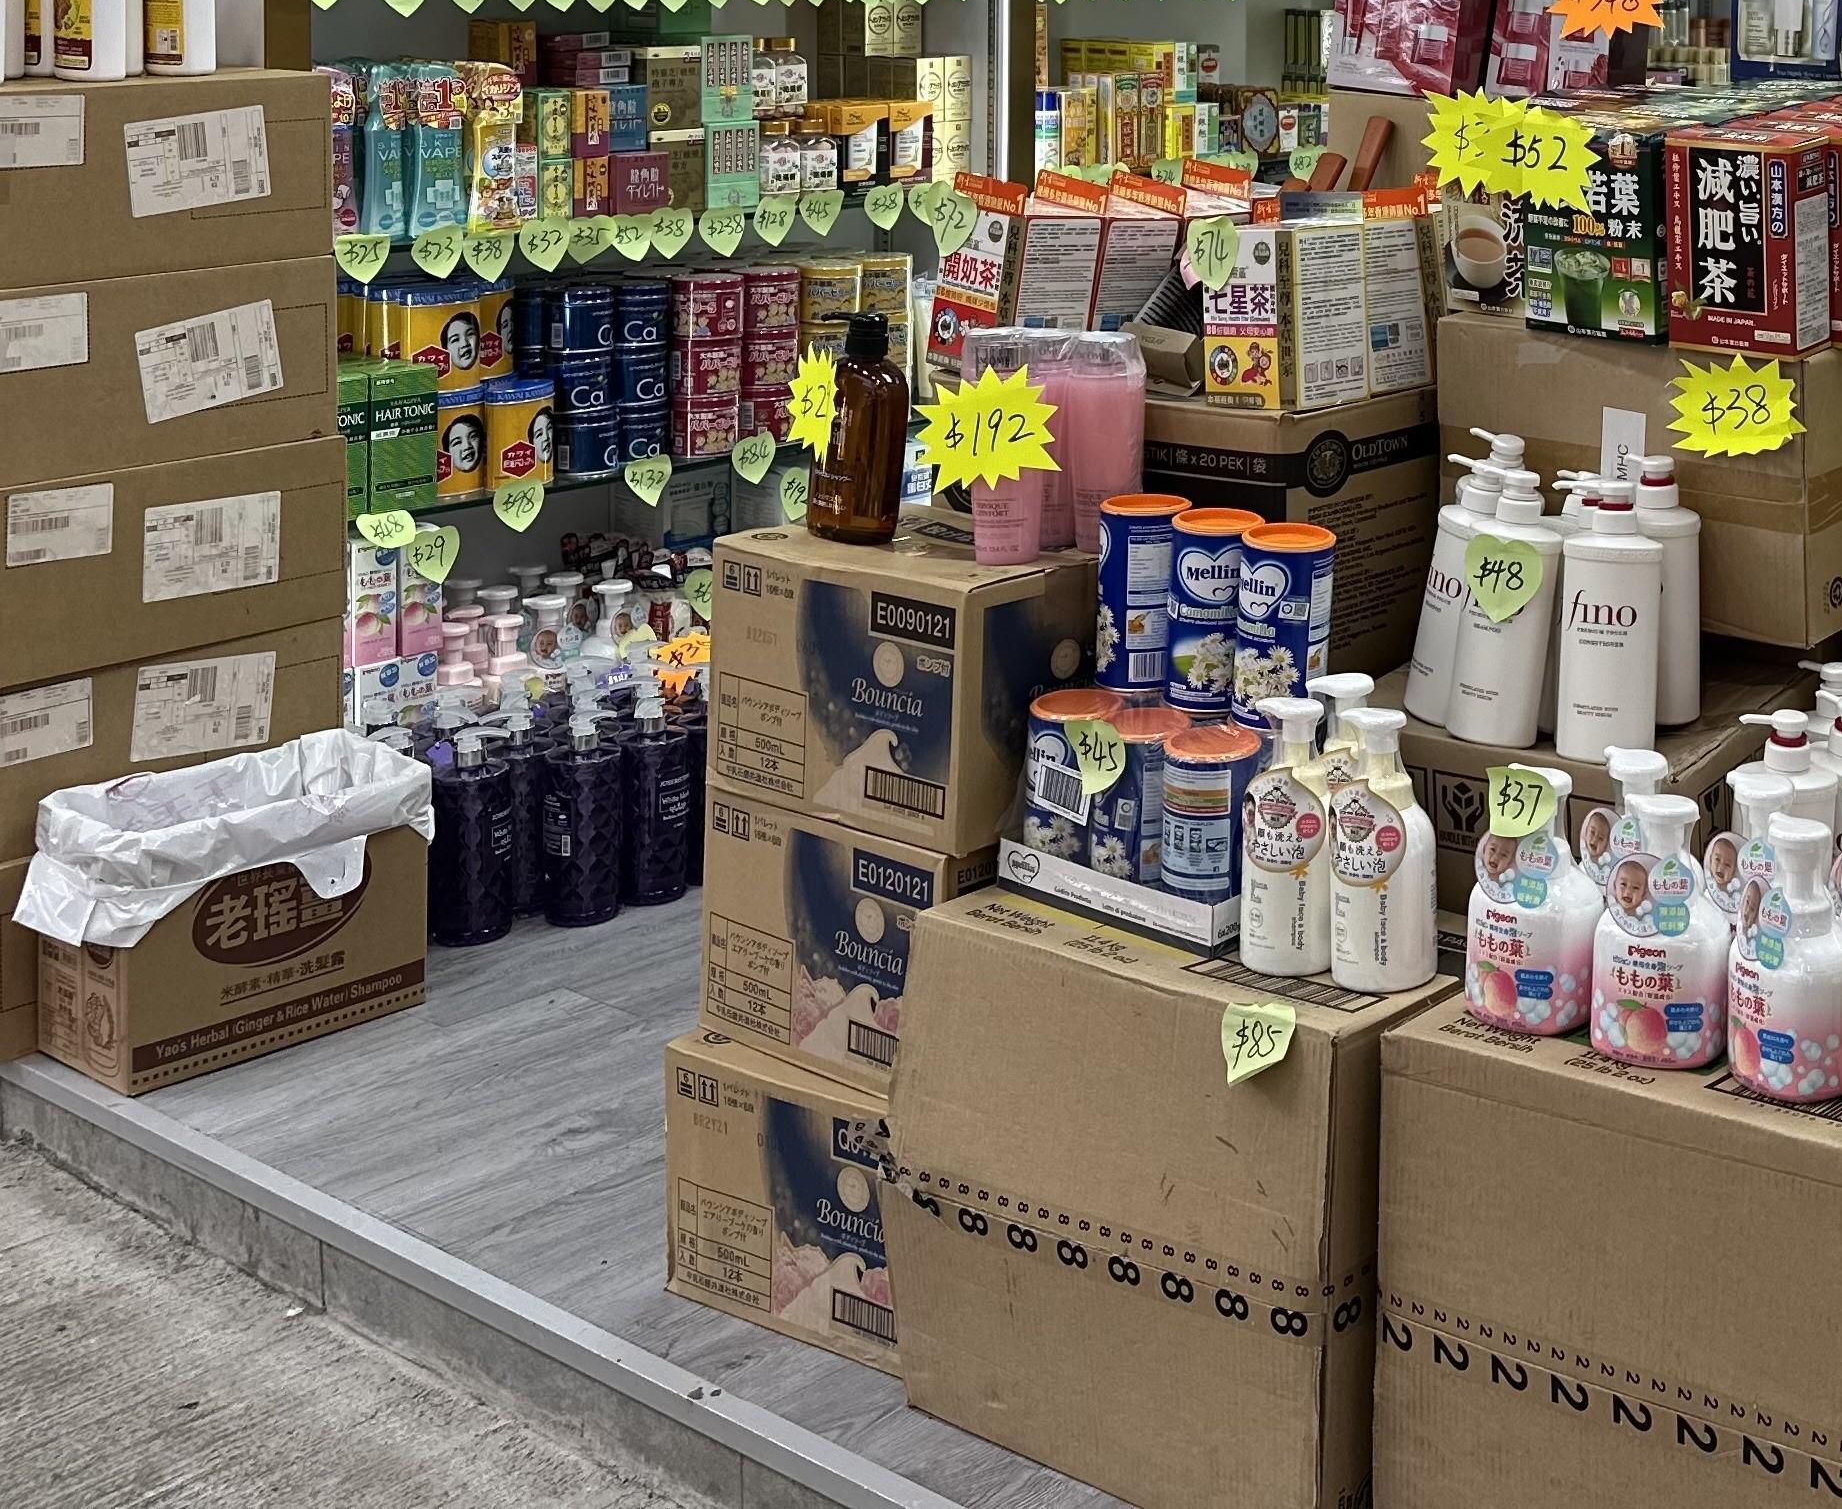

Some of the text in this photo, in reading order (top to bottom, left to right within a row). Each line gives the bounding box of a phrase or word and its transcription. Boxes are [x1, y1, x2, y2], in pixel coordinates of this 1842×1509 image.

[421, 146, 462, 159] VAPE
[1501, 129, 1569, 172] $52
[1770, 166, 1785, 234] 山本漢方の
[653, 218, 685, 238] $38
[707, 214, 743, 236] $238
[758, 210, 788, 228] $128
[1608, 218, 1642, 240] 粉末
[1697, 157, 1738, 304] 減肥茶
[344, 241, 382, 263] $25
[419, 237, 455, 261] $23
[472, 240, 503, 262] $38
[528, 231, 562, 254] $32
[1193, 230, 1229, 276] $74
[1209, 284, 1270, 317] 七星茶
[624, 321, 657, 342] Ca
[571, 386, 604, 408] Ca
[637, 378, 665, 398] Ca
[375, 403, 436, 423] HAIR TONIC
[1702, 385, 1772, 434] $38
[944, 408, 1035, 457] $192
[1199, 453, 1244, 470] 20 PEK
[413, 536, 445, 567] $29
[1186, 564, 1240, 581] Mellin
[1473, 556, 1525, 593] $48
[877, 602, 952, 640] E0090121
[1567, 589, 1638, 631] fino
[851, 677, 924, 718] Bouncia
[1079, 736, 1116, 771] $45
[1501, 775, 1543, 825] $37
[1251, 839, 1305, 860] やさしい泡
[1335, 853, 1387, 875] やさしい泡
[858, 858, 930, 901] E0120121
[835, 930, 904, 976] Bouncia
[1478, 930, 1525, 958] ももの葉
[1628, 944, 1667, 960] pigeon
[1615, 969, 1675, 992] ももの葉
[155, 1039, 188, 1061] Yao's
[190, 1025, 230, 1051] Herbal
[286, 1003, 310, 1018] Rice
[350, 973, 403, 1001] Shampoo
[1233, 1019, 1282, 1069] $85
